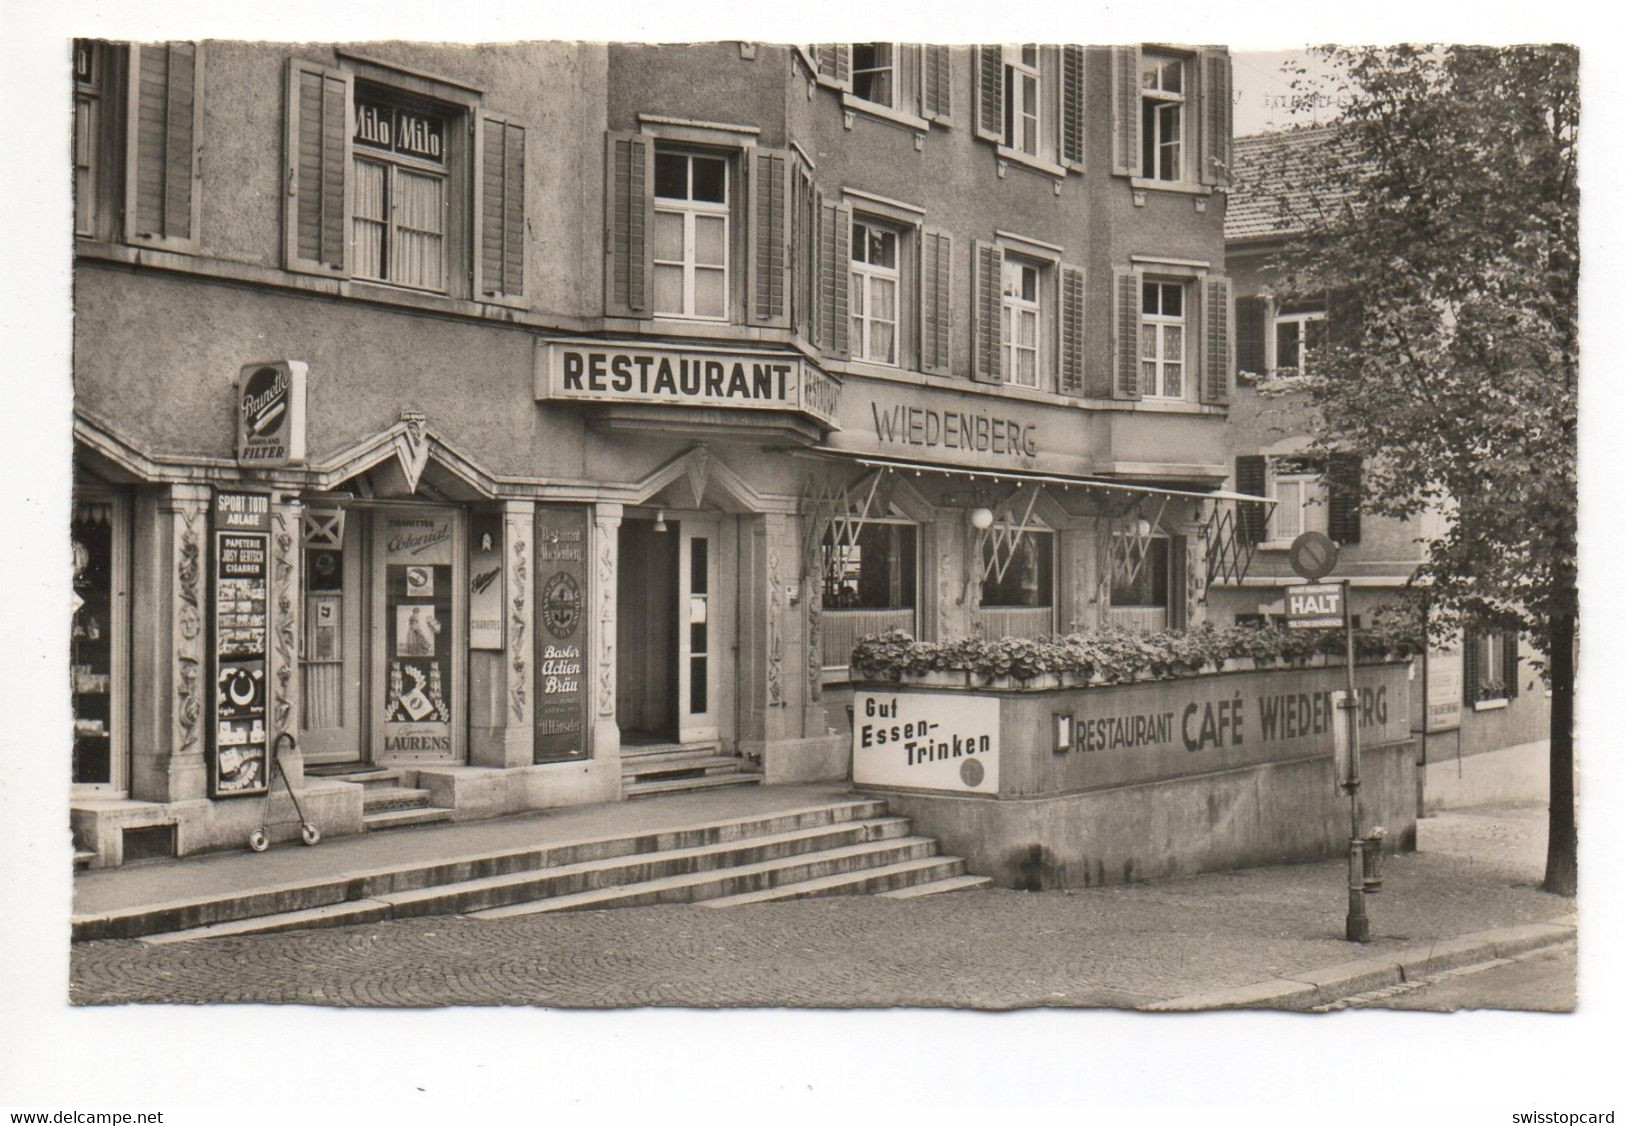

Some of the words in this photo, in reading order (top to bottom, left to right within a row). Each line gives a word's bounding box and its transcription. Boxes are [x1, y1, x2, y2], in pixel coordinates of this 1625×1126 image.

[397, 115, 440, 156] Milo
[563, 351, 792, 401] RESTAURANT
[241, 371, 289, 421] Brunette
[872, 401, 1037, 458] WIEDENBERG
[242, 446, 285, 460] FILTER
[218, 494, 246, 512] SPORT
[248, 496, 268, 513] TOTO
[226, 513, 260, 526] ABLAGE
[225, 538, 261, 549] PAPETERIE
[387, 523, 451, 555] Colonial
[1290, 594, 1340, 615] HALT
[544, 645, 580, 659] Basler
[542, 659, 581, 676] Actien
[545, 676, 578, 693] Bräu
[865, 697, 897, 718] Gut
[1076, 713, 1174, 752] RESTAURANT
[1181, 690, 1243, 753] CAFÉ
[1258, 685, 1387, 741] WIEDENRG
[384, 737, 450, 751] LAURENS
[861, 720, 939, 748] Essen-
[904, 734, 990, 766] Trinken
